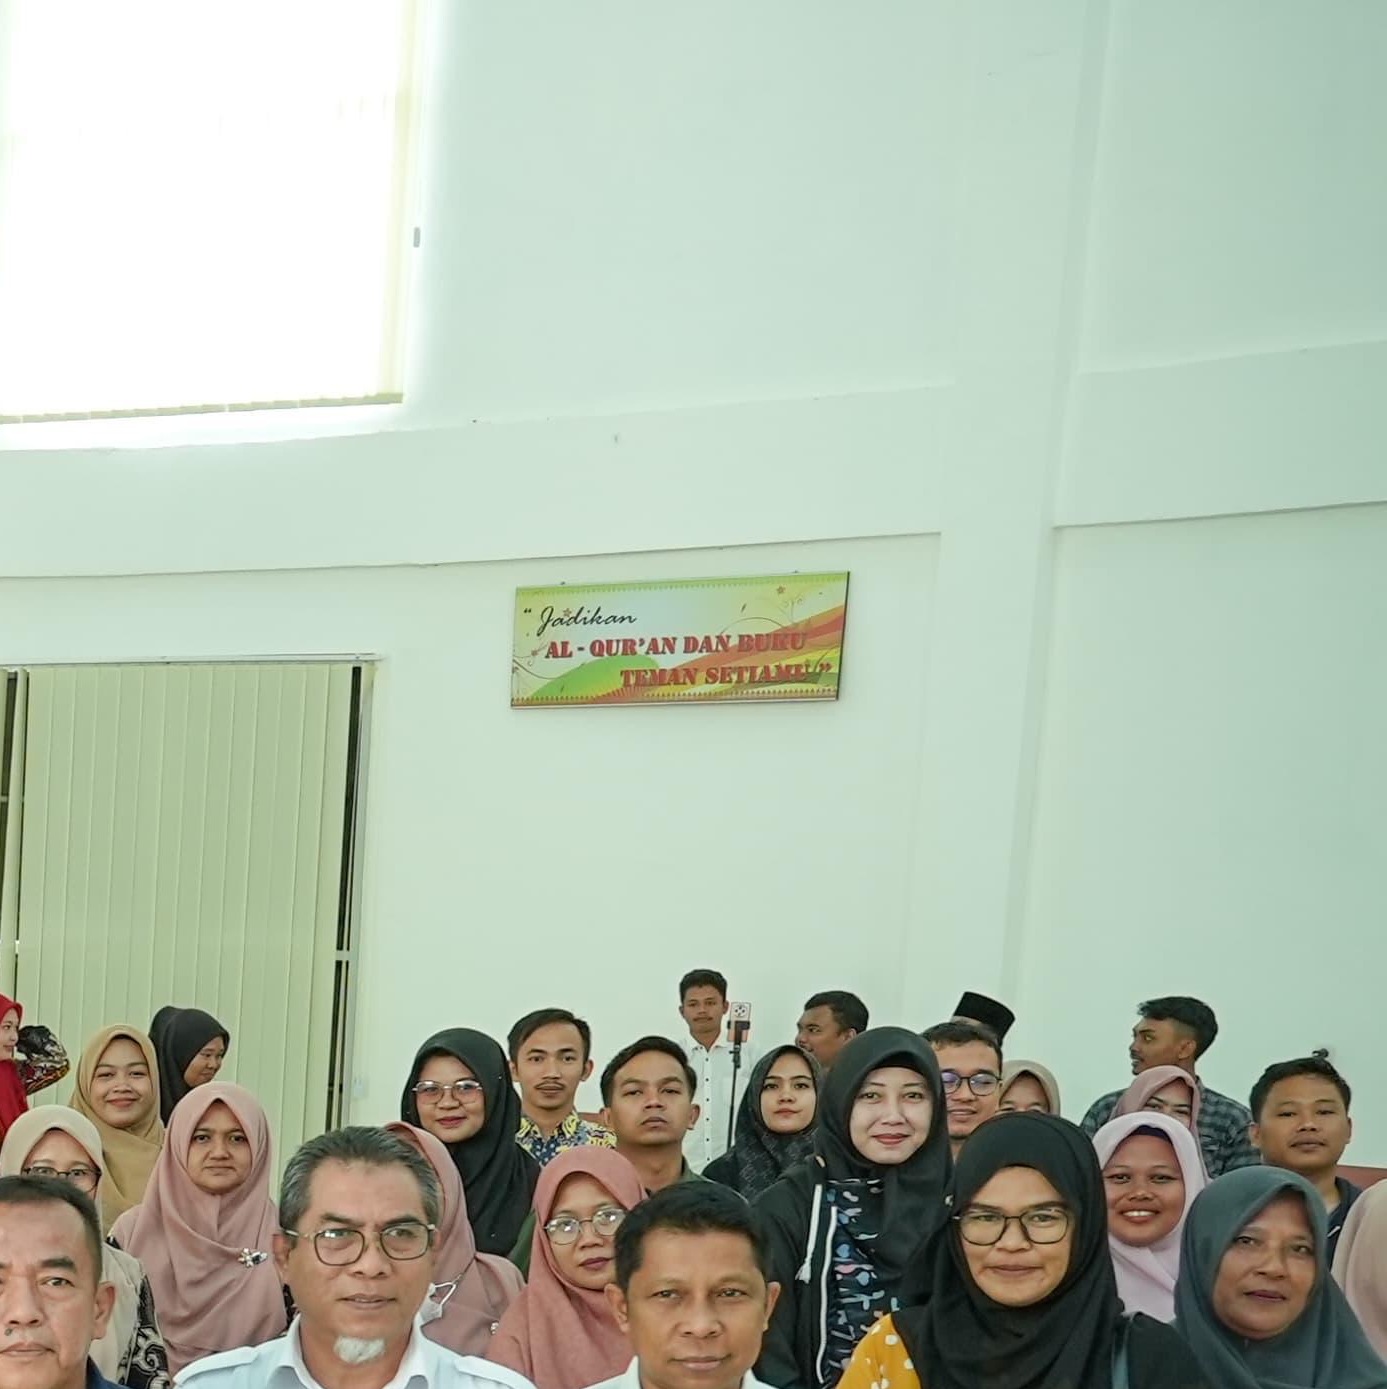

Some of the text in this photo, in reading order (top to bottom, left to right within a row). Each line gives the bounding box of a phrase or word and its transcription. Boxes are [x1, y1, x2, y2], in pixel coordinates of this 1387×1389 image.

[536, 605, 638, 637] Jadikan
[545, 640, 574, 659] AL
[683, 634, 733, 653] DAN
[737, 631, 807, 652] BUKU
[620, 667, 699, 687] TEMAN
